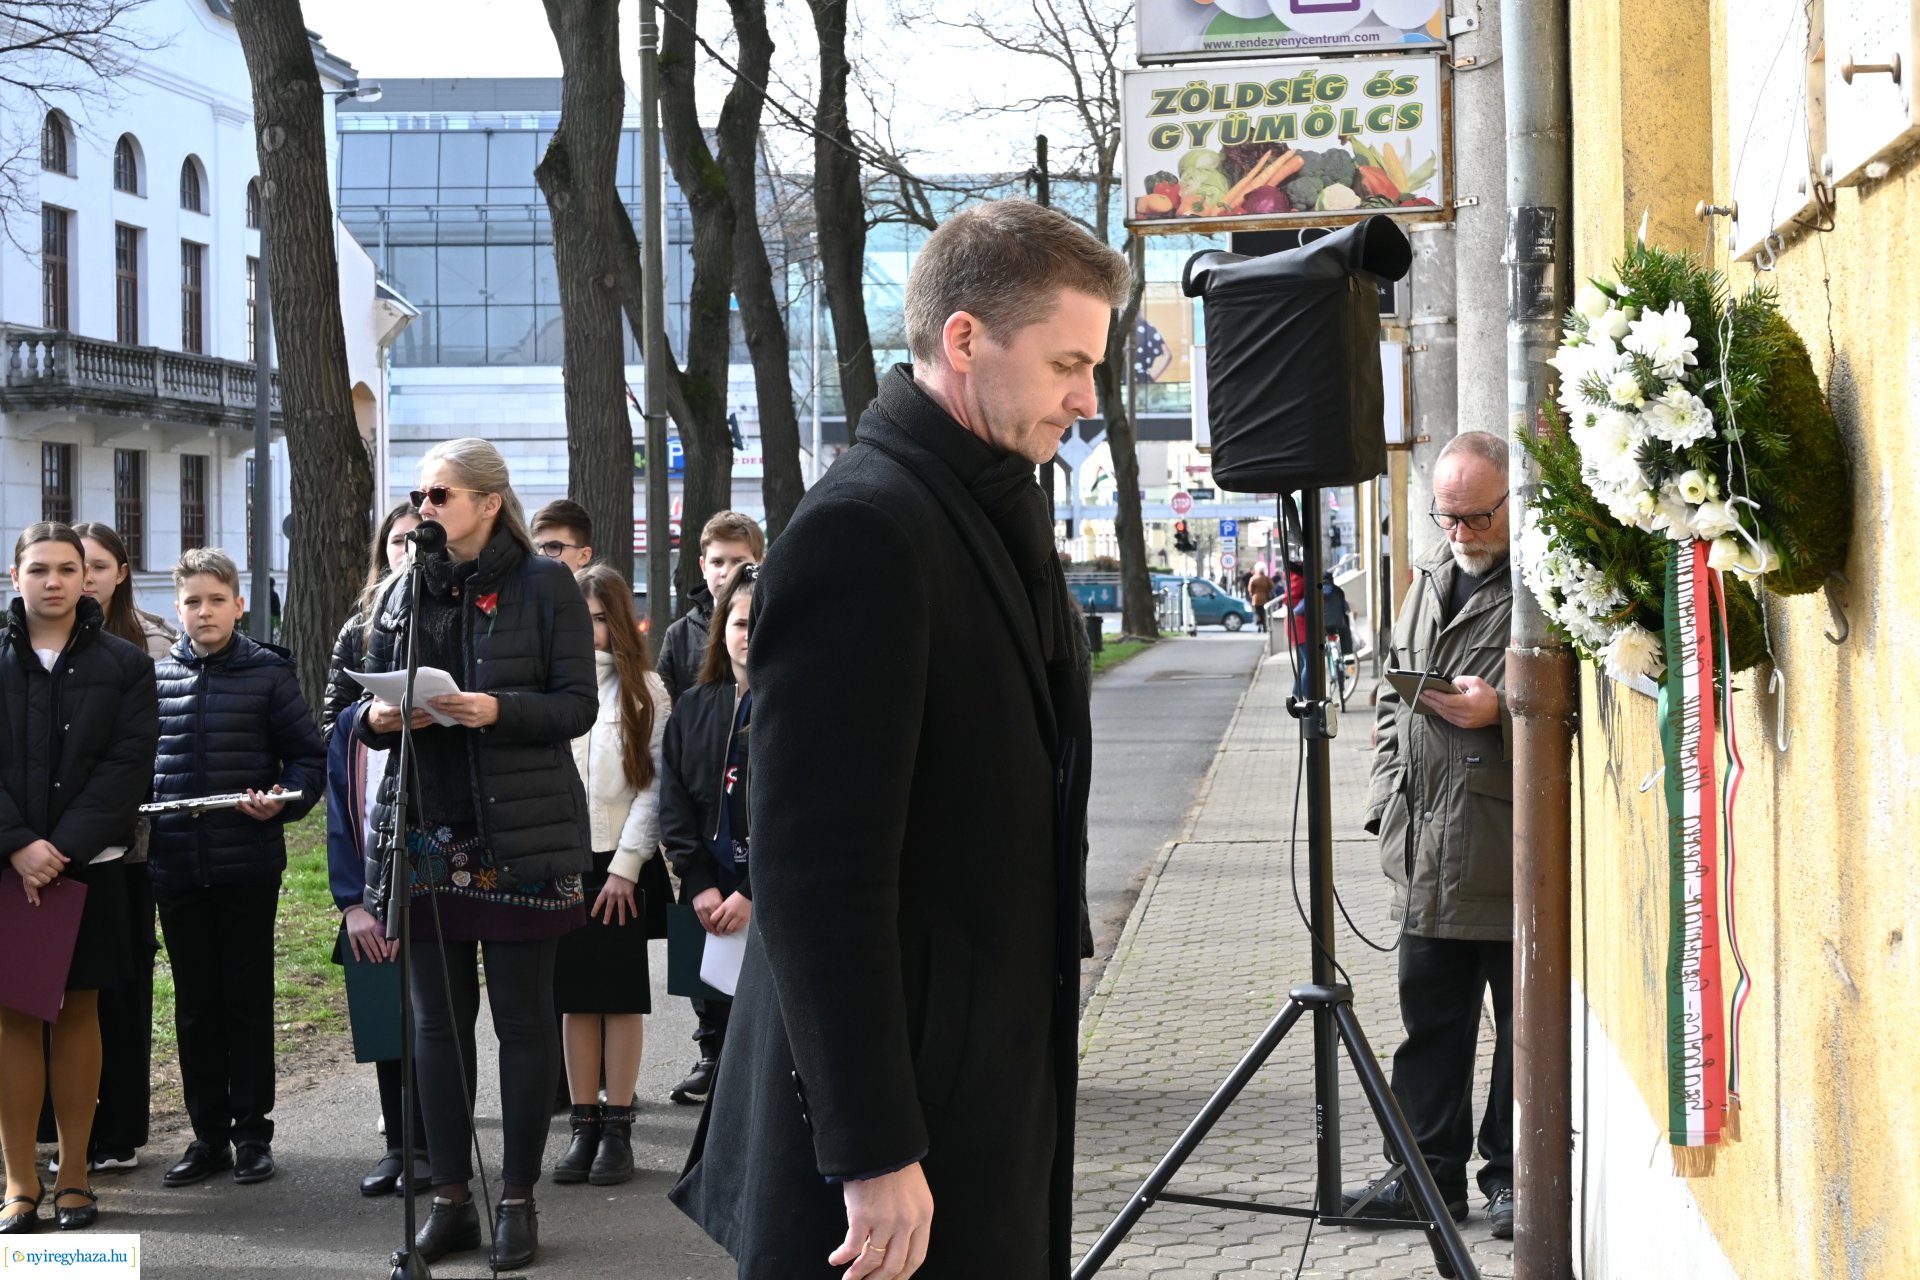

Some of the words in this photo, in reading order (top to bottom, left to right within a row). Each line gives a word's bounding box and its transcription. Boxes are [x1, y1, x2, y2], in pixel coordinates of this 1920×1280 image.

[1203, 32, 1380, 50] www.rendezvenycentrum.com
[1146, 69, 1348, 118] ZÖLDSÉG
[1363, 70, 1419, 98] és
[1149, 102, 1424, 151] GYÜMÖLCS
[1173, 498, 1190, 509] STOP
[1224, 525, 1232, 535] P
